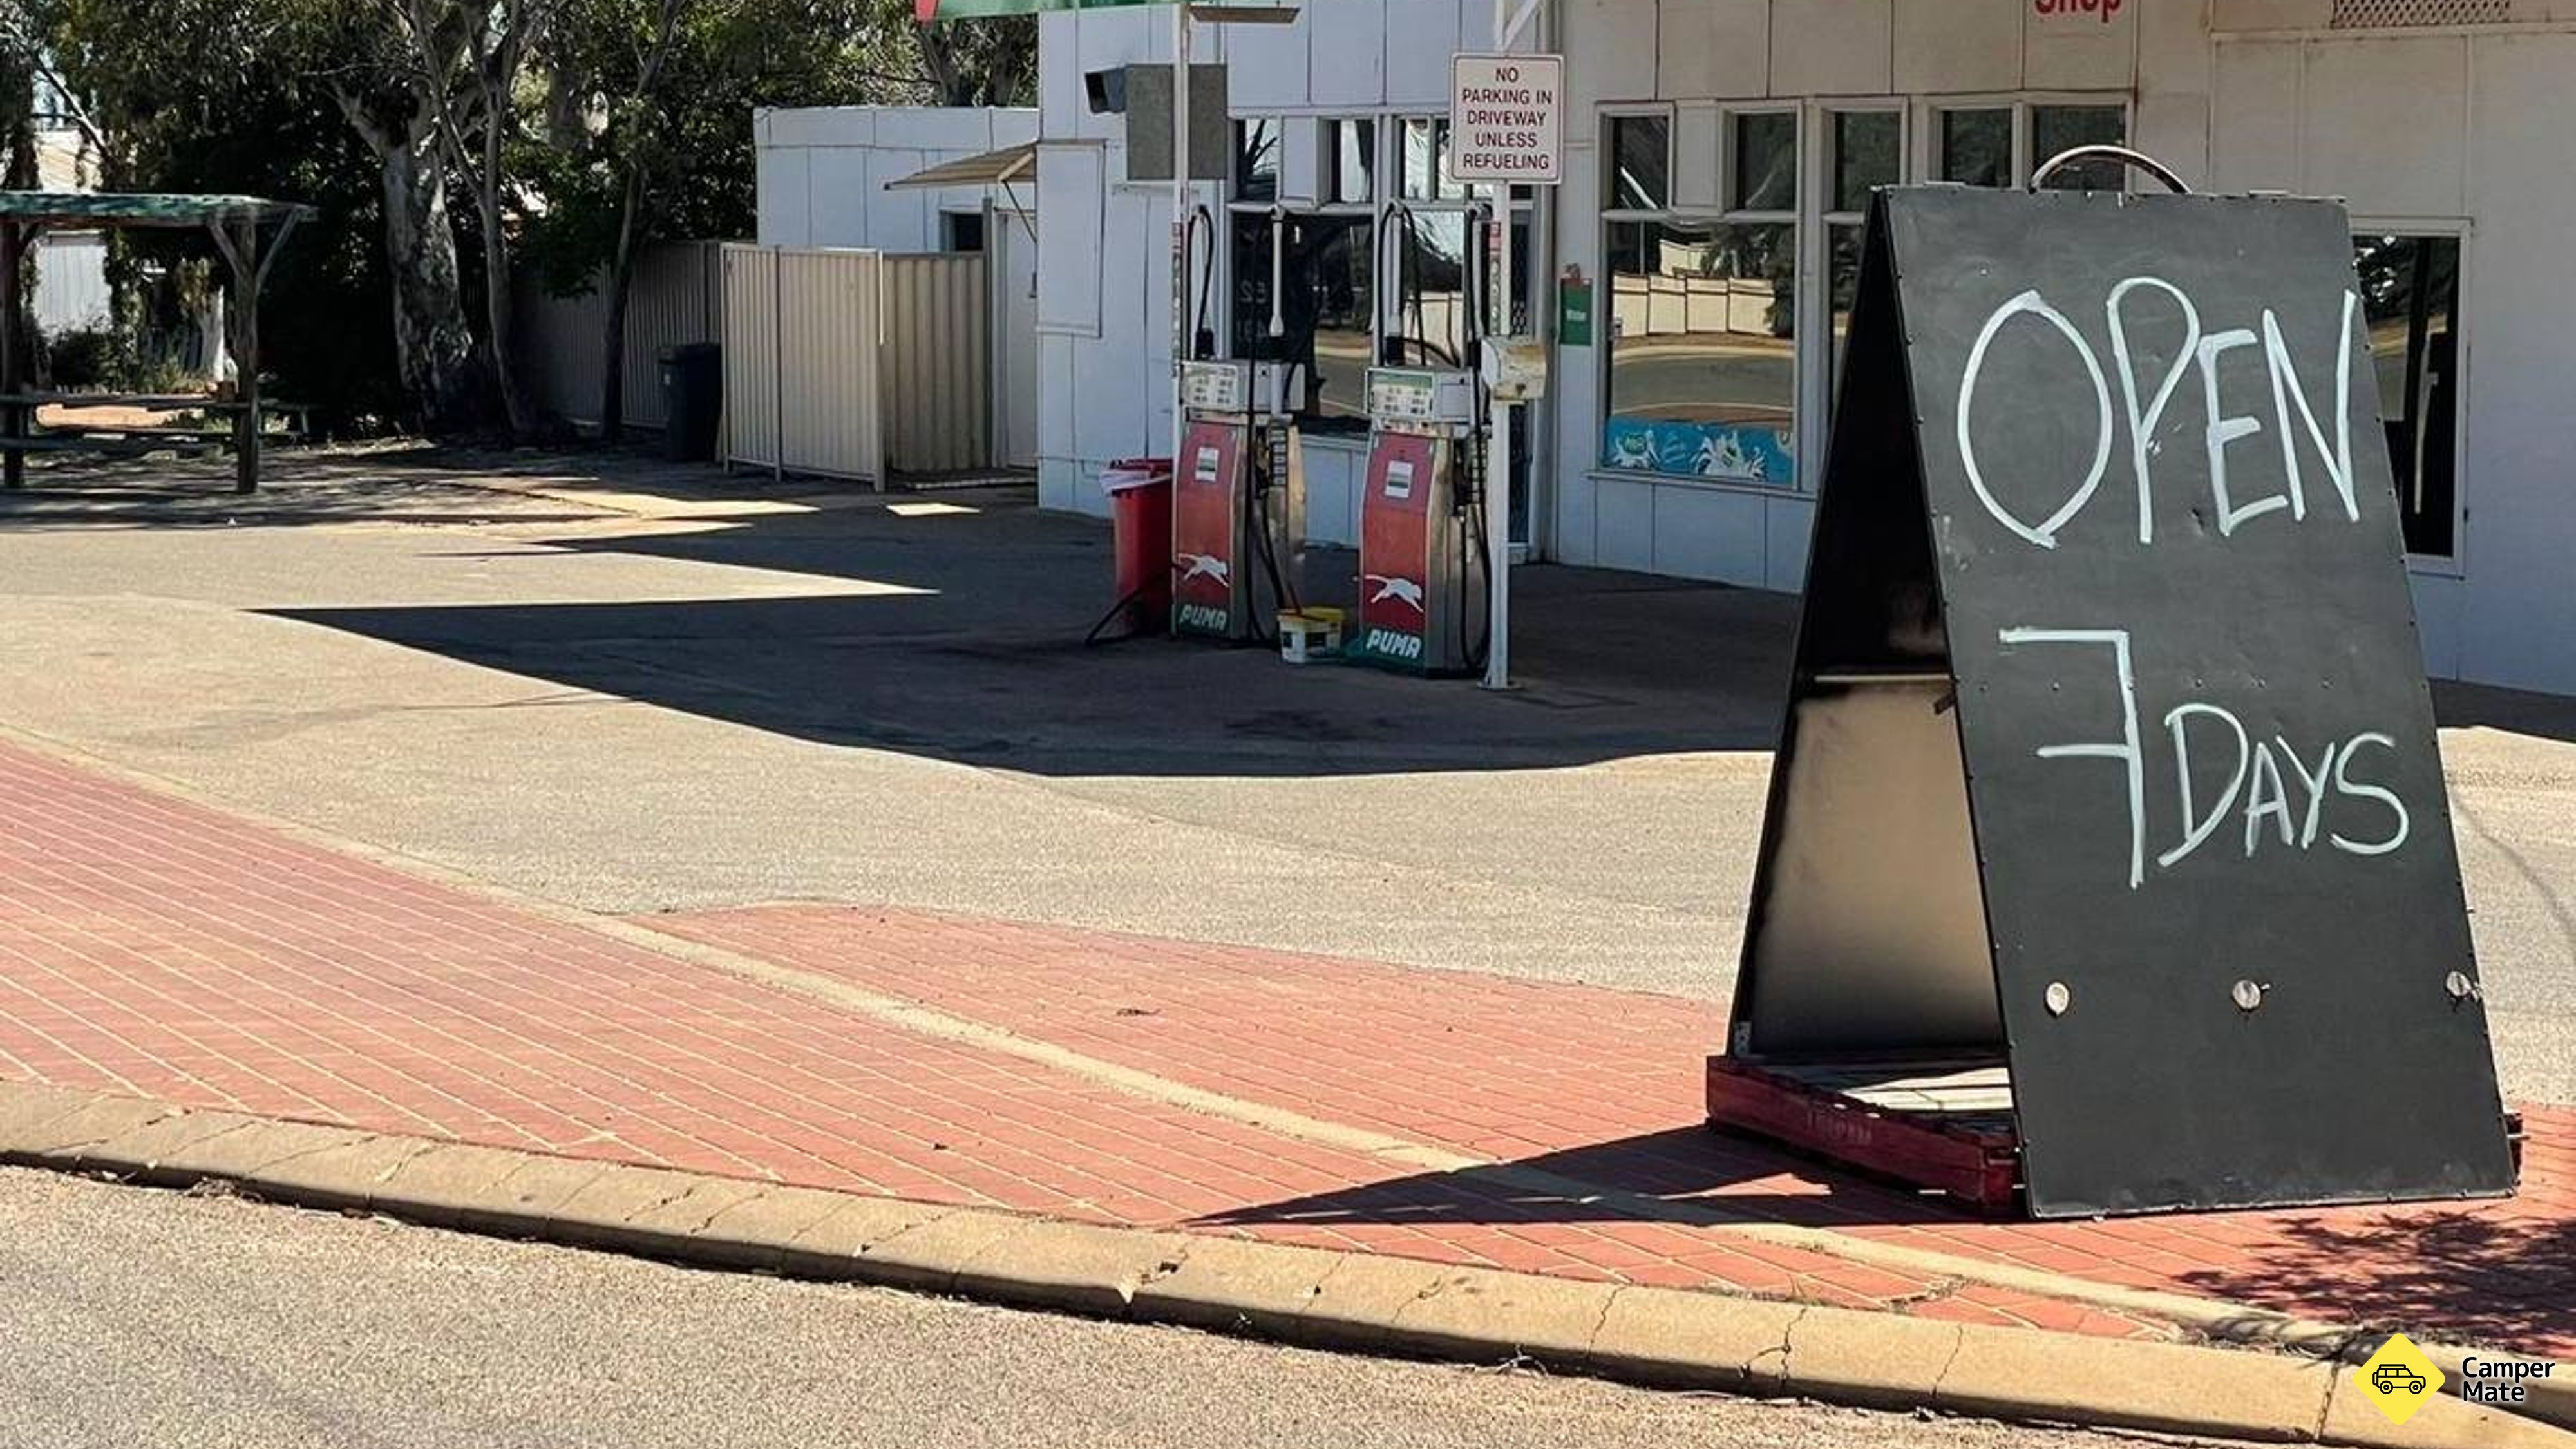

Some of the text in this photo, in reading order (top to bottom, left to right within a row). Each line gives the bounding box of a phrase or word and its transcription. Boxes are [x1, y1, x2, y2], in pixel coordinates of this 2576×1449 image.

[1495, 67, 1519, 83] NO
[1461, 88, 1553, 105] PARKING IN
[1467, 109, 1547, 127] DRIVEWAY
[1475, 131, 1538, 148] UNLESS
[1463, 153, 1549, 170] REFUELING
[1957, 277, 2360, 549] OPEN
[1179, 604, 1227, 631] PUMA
[1366, 629, 1421, 658] PUMA
[1998, 627, 2409, 890] 7 DAYS
